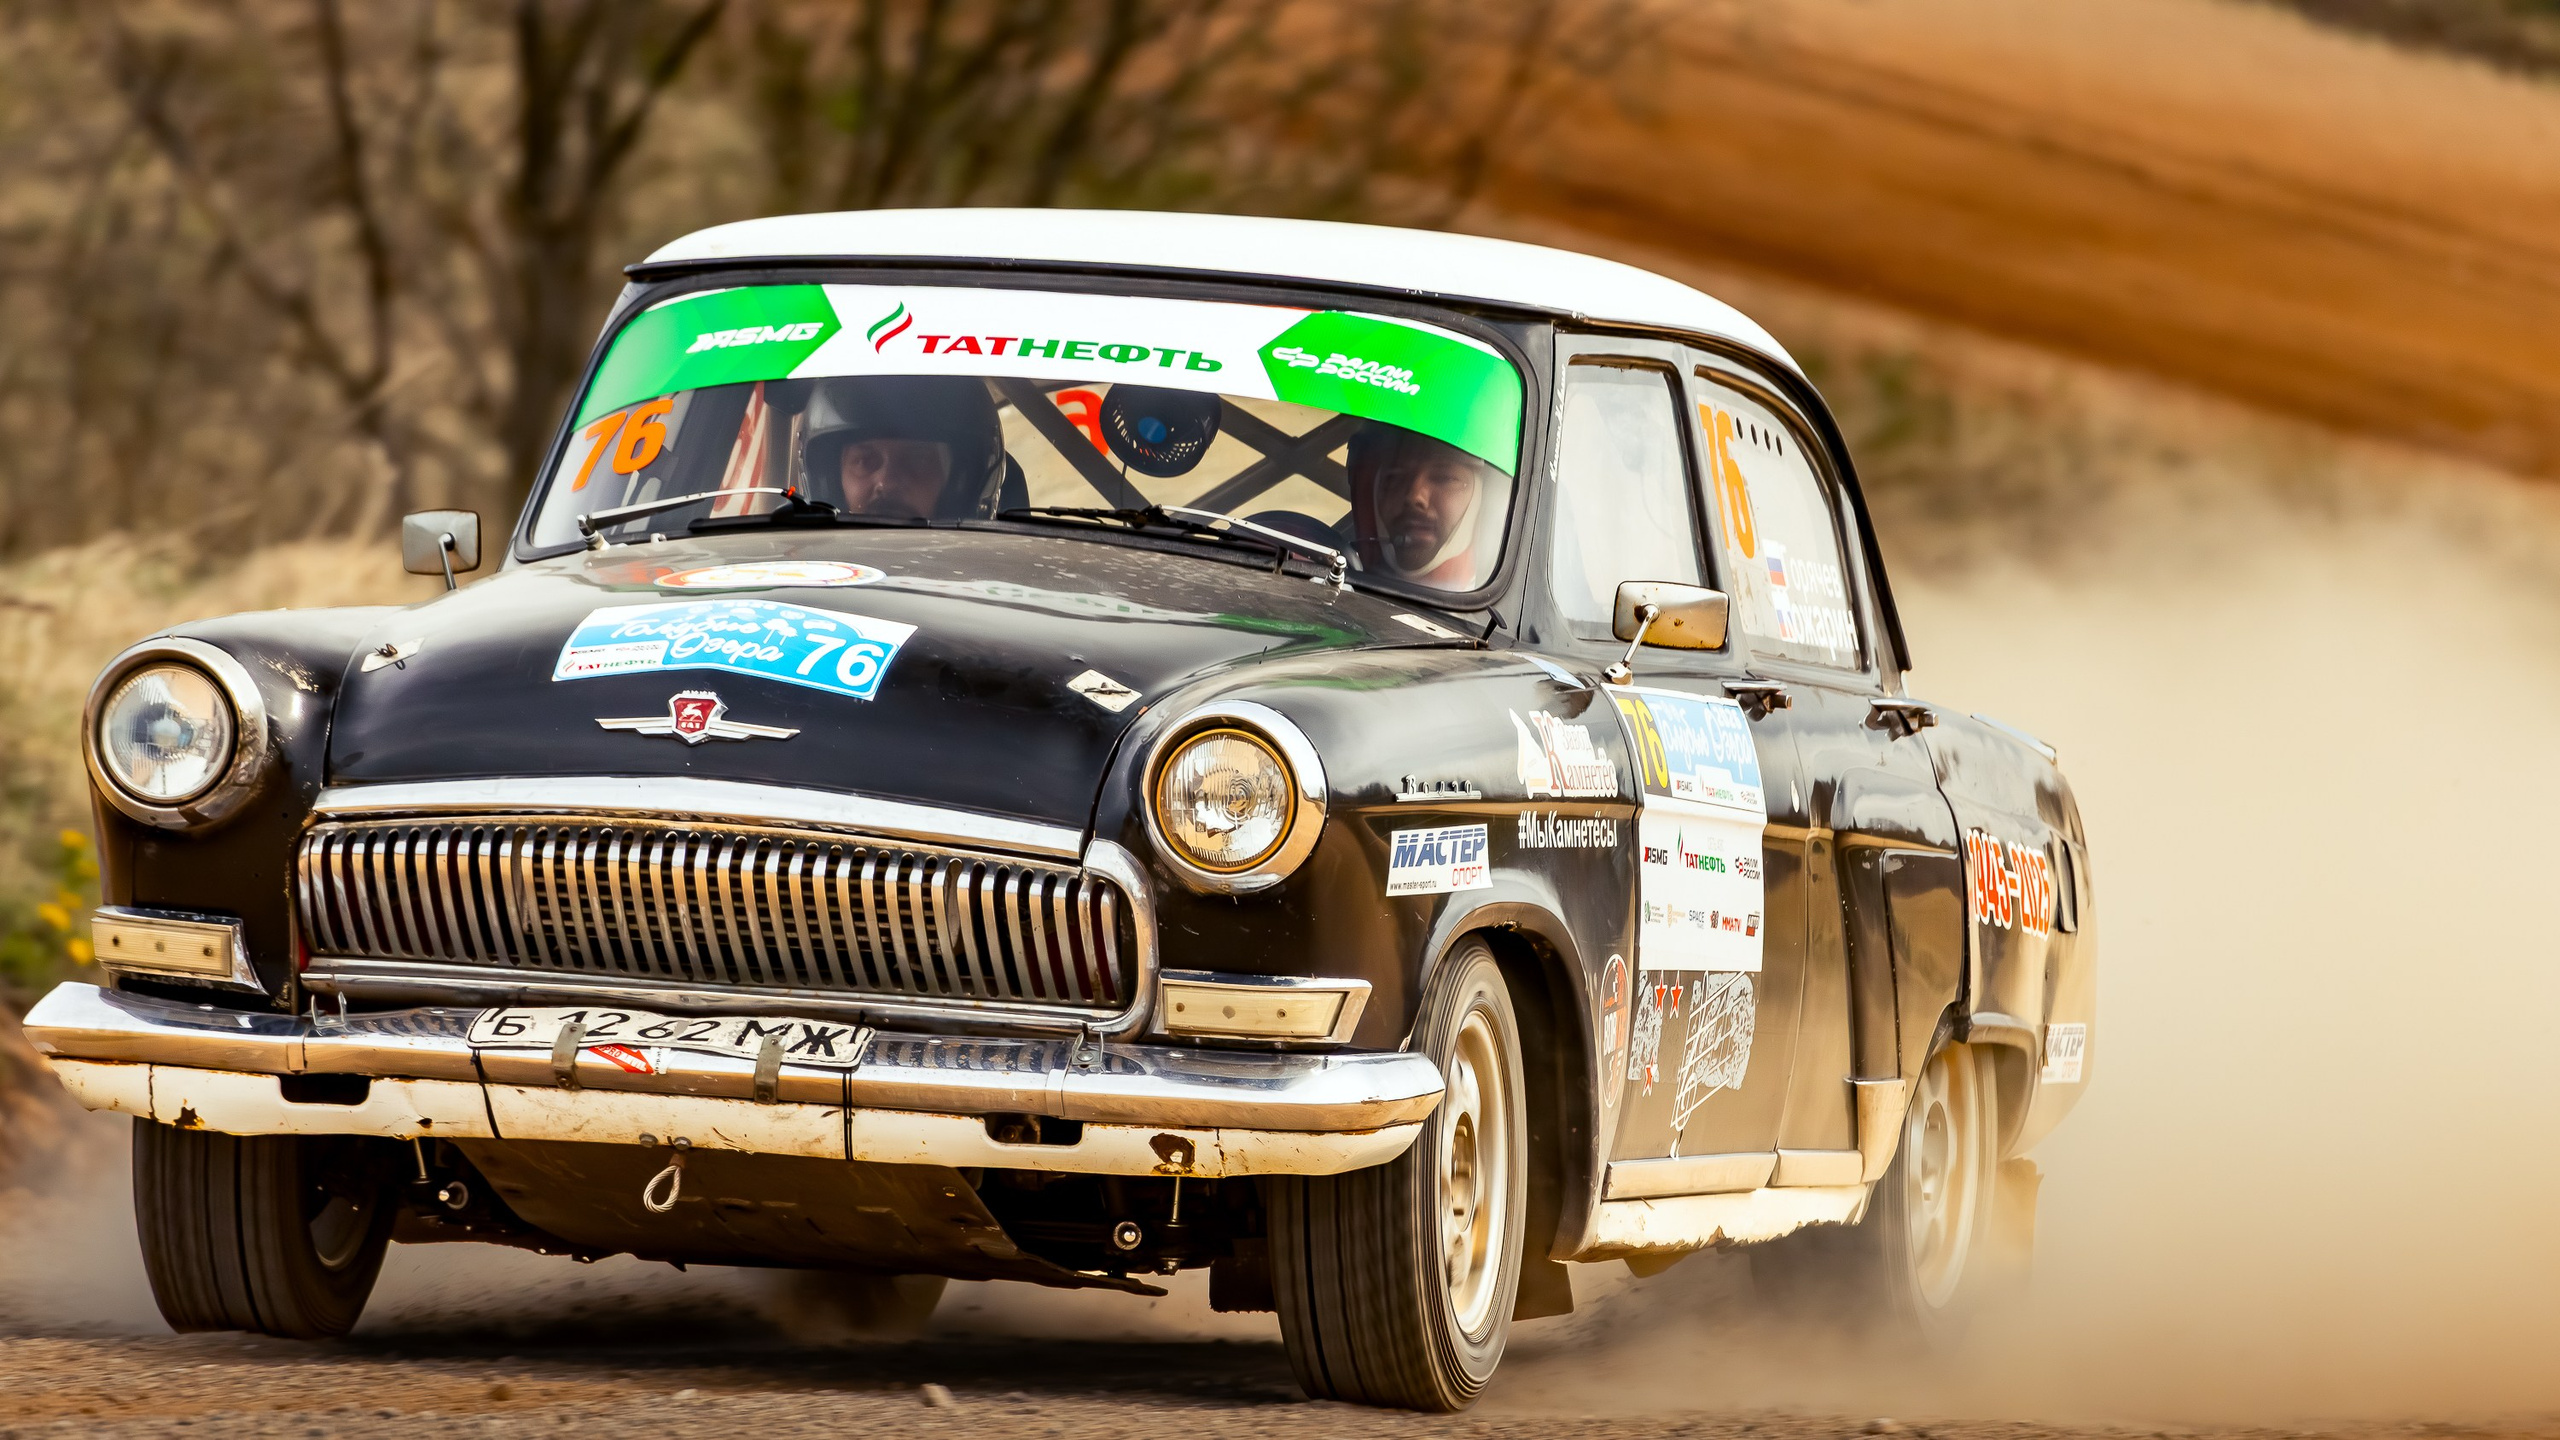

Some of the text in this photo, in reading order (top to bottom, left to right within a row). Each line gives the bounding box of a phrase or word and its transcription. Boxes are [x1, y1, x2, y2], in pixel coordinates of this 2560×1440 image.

[917, 335, 1223, 372] ТАТНЕФТЬ
[1325, 353, 1413, 382] РАЛЛИ
[1315, 363, 1420, 396] РОССИИ
[571, 400, 673, 492] 76
[1699, 403, 1755, 559] 76
[670, 631, 784, 664] Озера
[795, 633, 885, 687] 76
[1616, 698, 1668, 789] 76
[1518, 810, 1617, 849] #МыКамнетёсы
[1392, 827, 1486, 869] МАСТЕР
[1646, 847, 1668, 866] ASMG
[1685, 853, 1726, 873] ТАТНЕФТЬ
[1452, 866, 1483, 887] СПОРТ
[491, 1016, 531, 1036] Б
